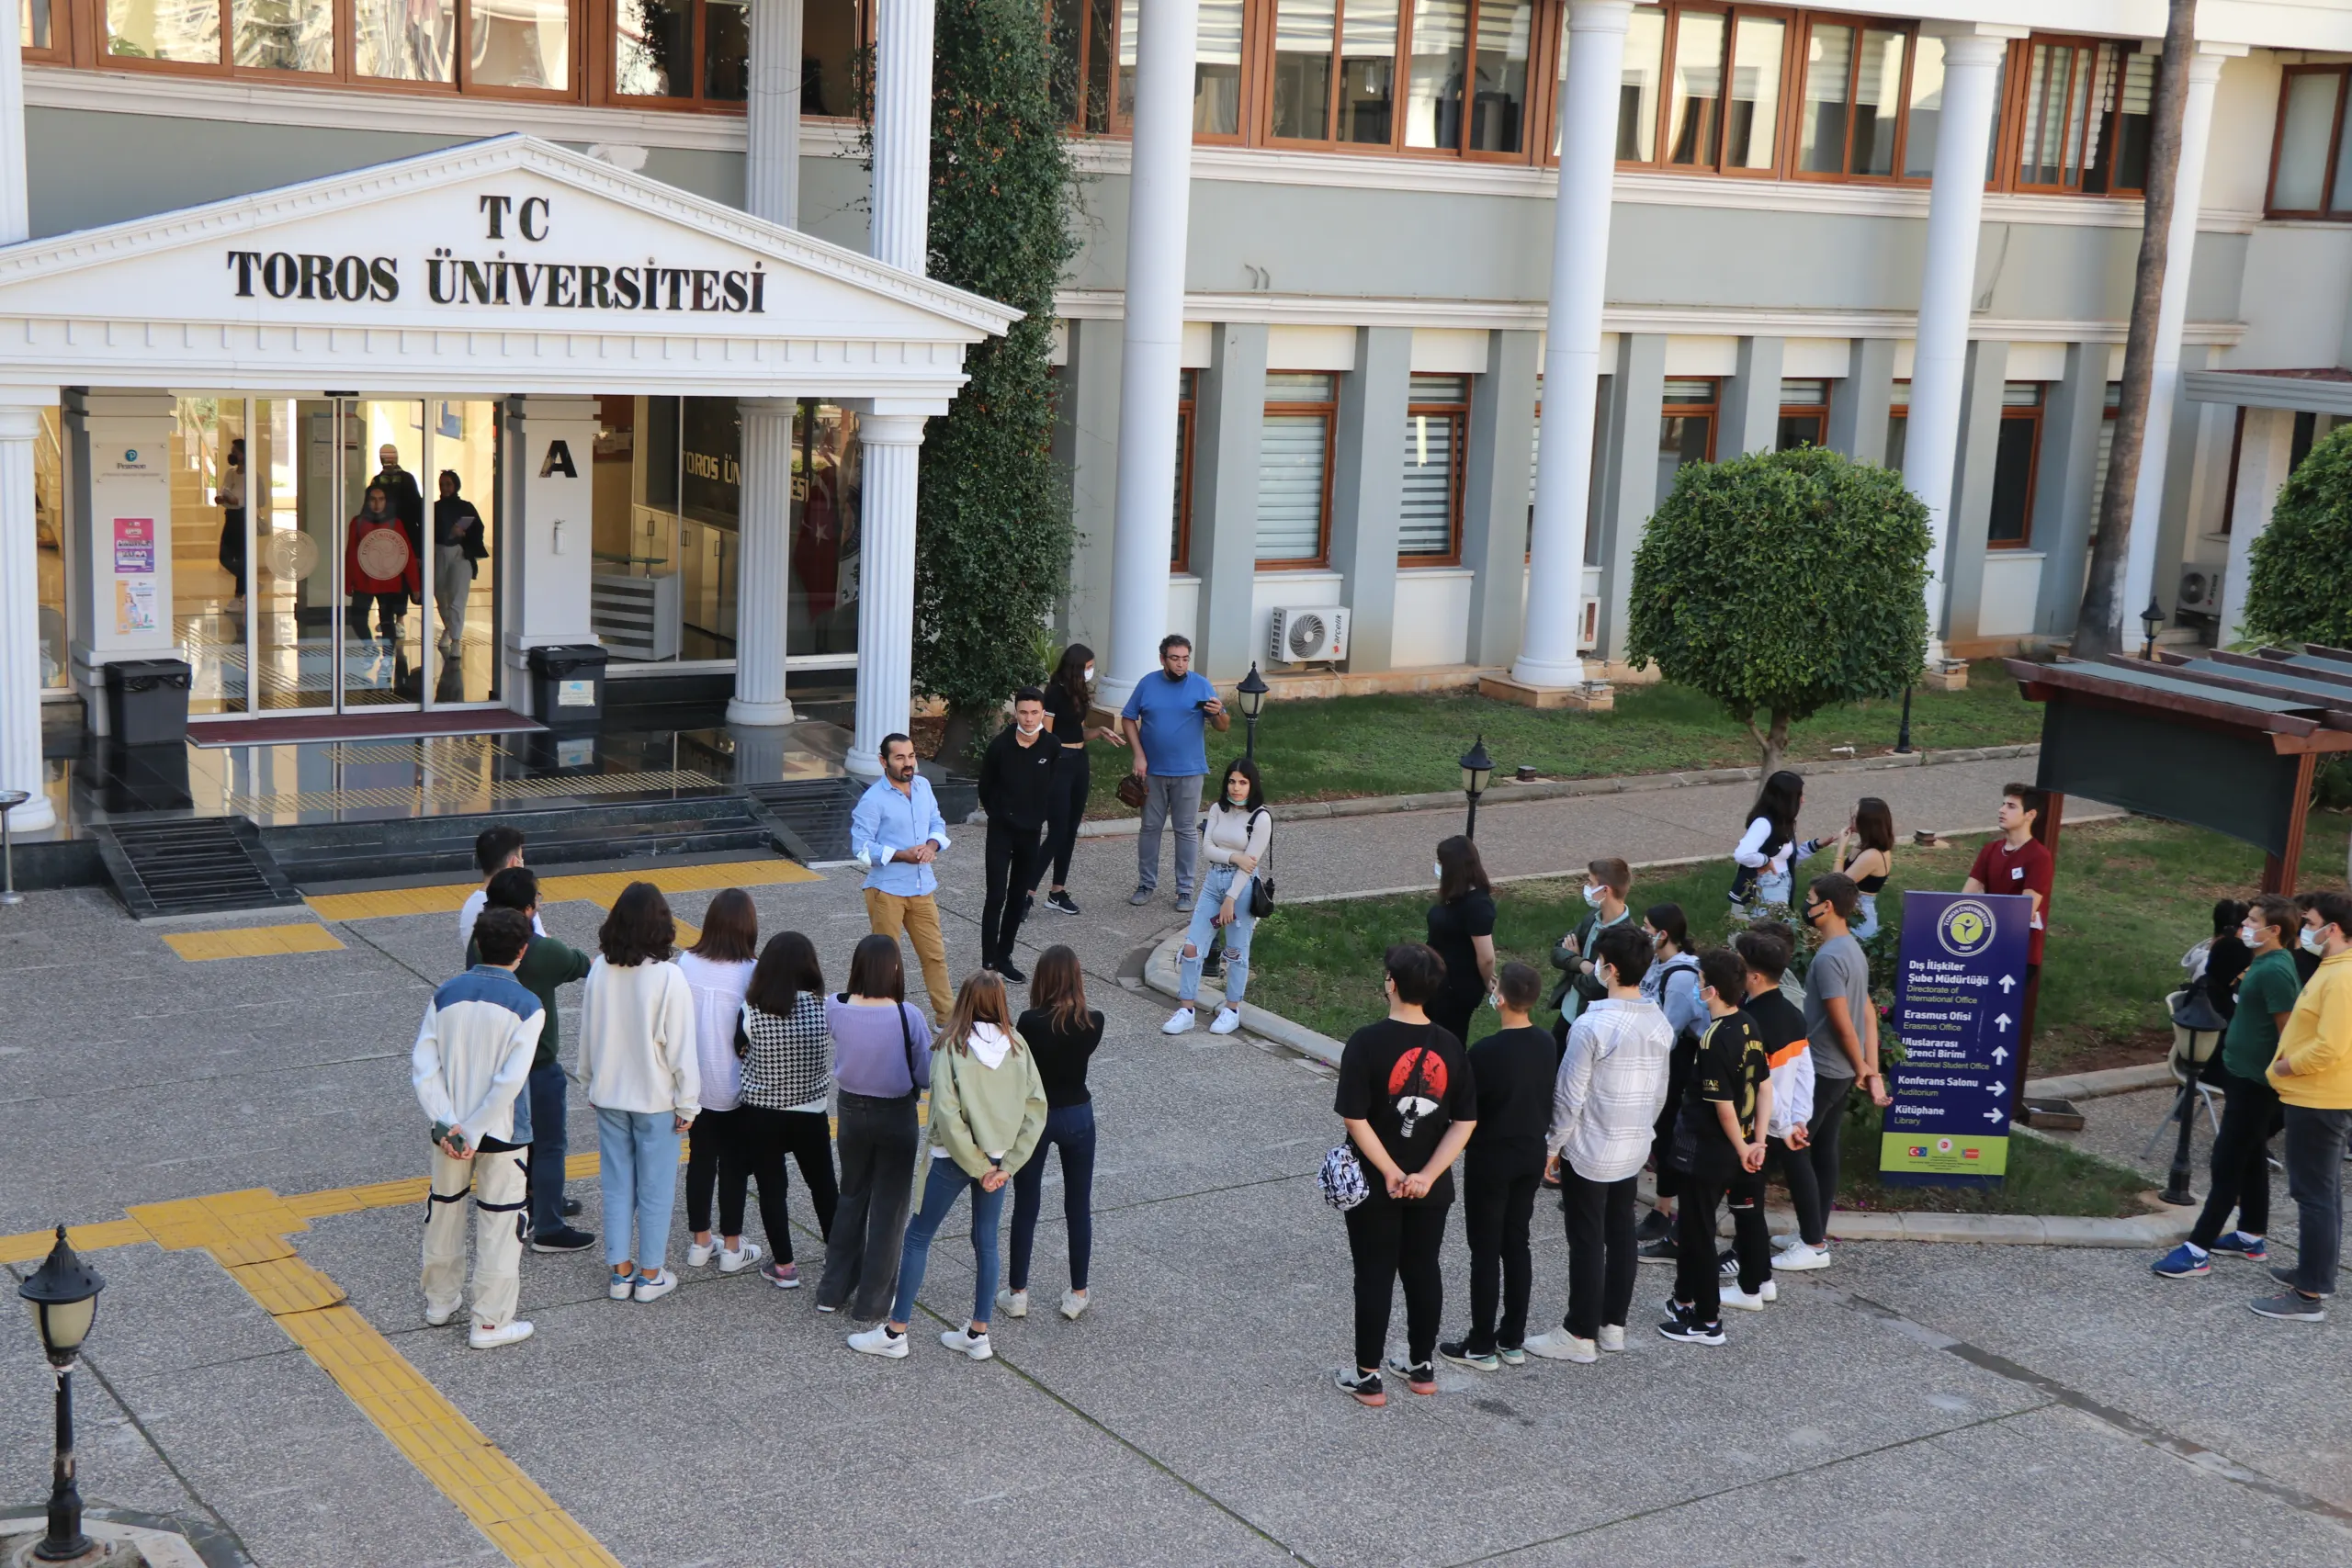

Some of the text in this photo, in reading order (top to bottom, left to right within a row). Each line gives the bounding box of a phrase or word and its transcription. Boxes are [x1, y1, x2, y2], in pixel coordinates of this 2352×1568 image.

[228, 247, 766, 313] TOROS ÜNİVERSİTESİ
[538, 440, 578, 478] A
[1334, 614, 1342, 644] arçelik
[1908, 959, 1965, 972] Dış İlişkiler
[1908, 974, 1989, 987] Şube Müdürlüğü
[1906, 985, 1949, 994] Directorate
[1905, 995, 1977, 1004] International Office
[1904, 1010, 1972, 1021] Erasmus Ofisi
[1903, 1021, 1962, 1031] Erasmus Office
[1905, 1048, 1966, 1059] ğrenci Birimi
[1900, 1060, 1990, 1070] International Student Office
[1898, 1076, 1979, 1087] Konferans Salonu
[1897, 1088, 1939, 1097] Auditorium
[1895, 1105, 1945, 1116] Kütüphane
[1894, 1117, 1921, 1126] Library
